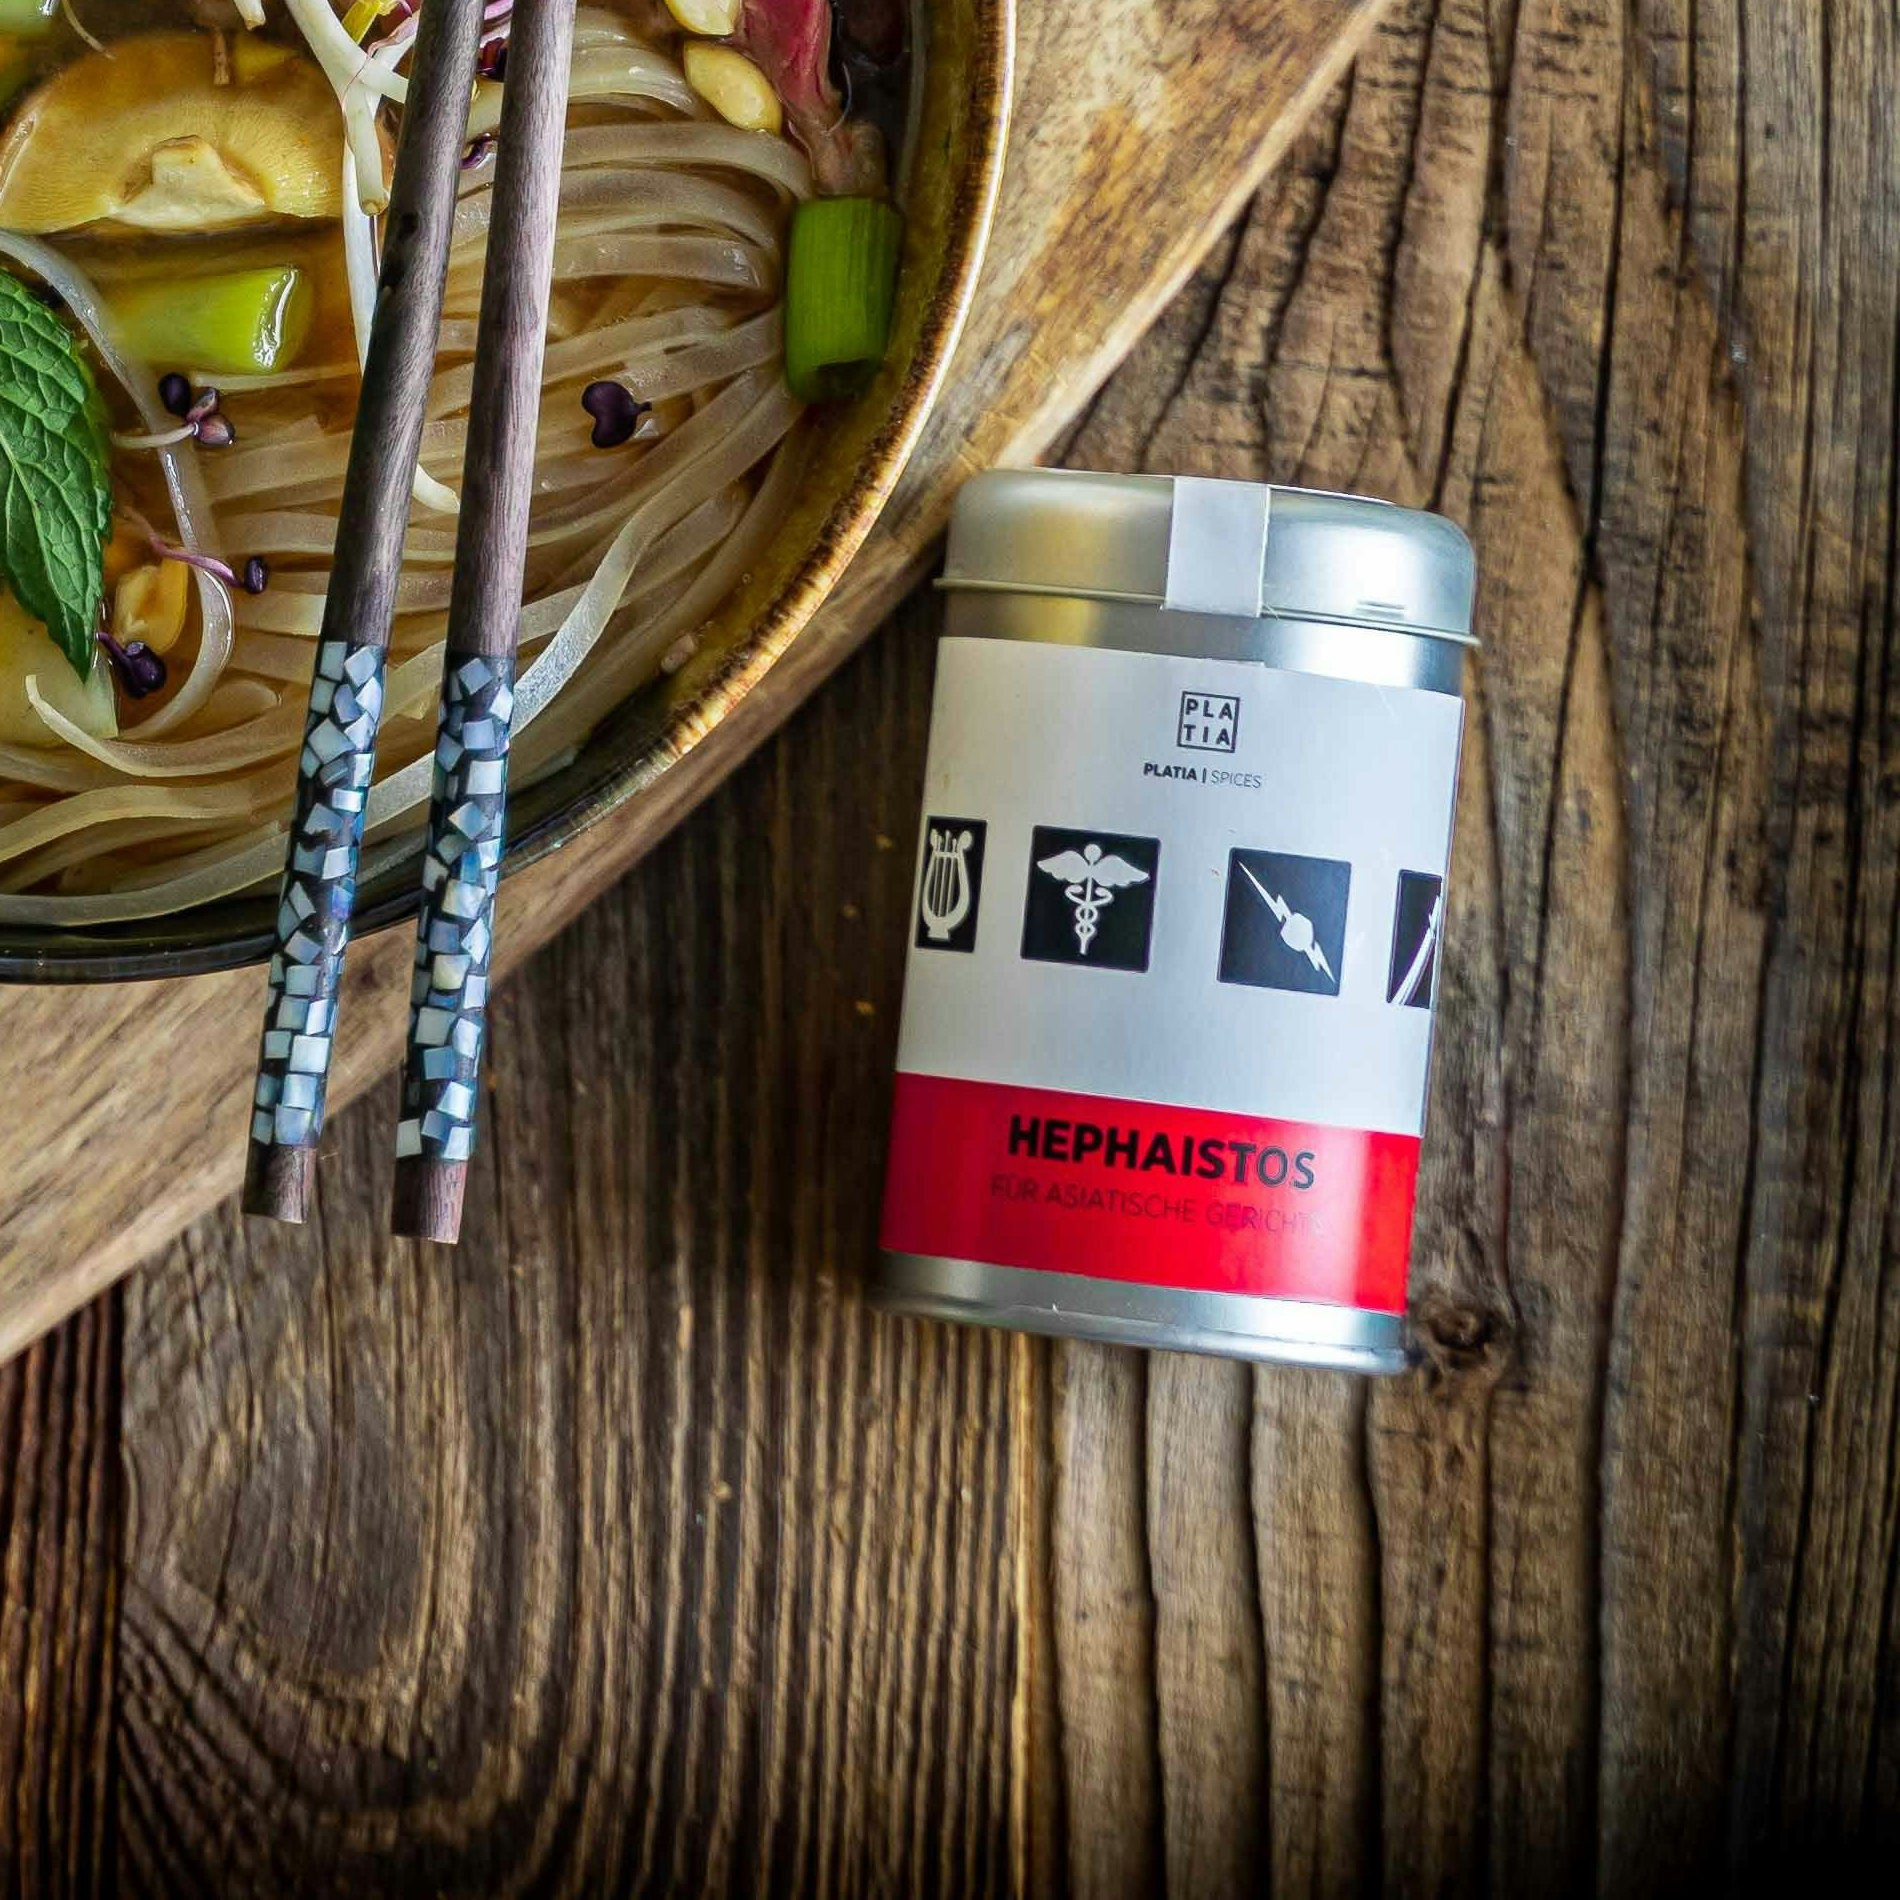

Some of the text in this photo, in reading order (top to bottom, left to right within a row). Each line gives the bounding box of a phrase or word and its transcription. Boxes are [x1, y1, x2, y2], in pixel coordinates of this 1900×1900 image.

[1184, 698, 1233, 720] PLA
[1183, 723, 1231, 745] TIA
[1143, 762, 1198, 781] PLATIA
[1210, 769, 1262, 789] SPICES
[1008, 1114, 1316, 1190] HEPHAISTOS
[990, 1171, 1326, 1239] FÜR ASIATISCHE GERICHT
